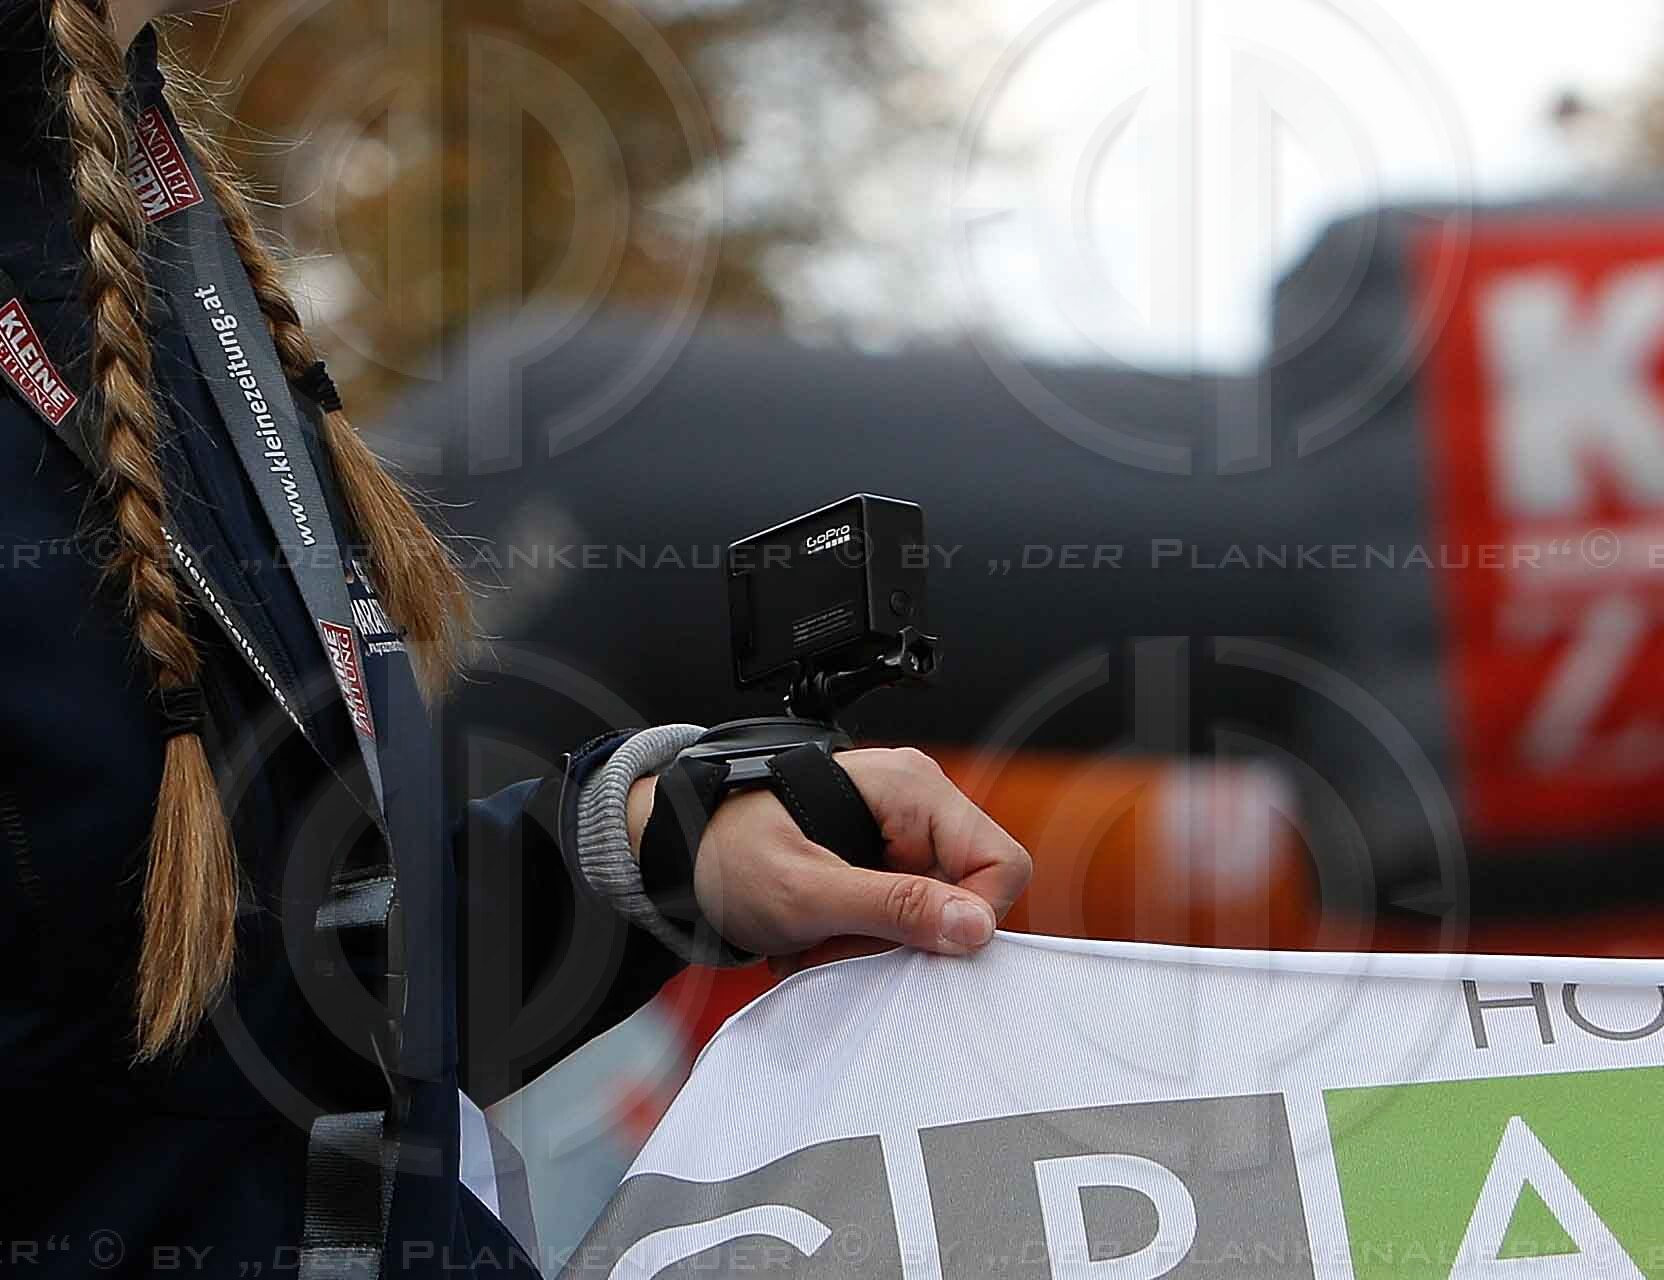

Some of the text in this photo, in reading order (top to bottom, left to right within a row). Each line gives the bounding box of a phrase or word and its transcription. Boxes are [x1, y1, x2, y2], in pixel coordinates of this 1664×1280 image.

[143, 112, 194, 204] ZEITUNG
[193, 283, 317, 547] www.kleinezeitung.at
[805, 523, 851, 549] GoPro
